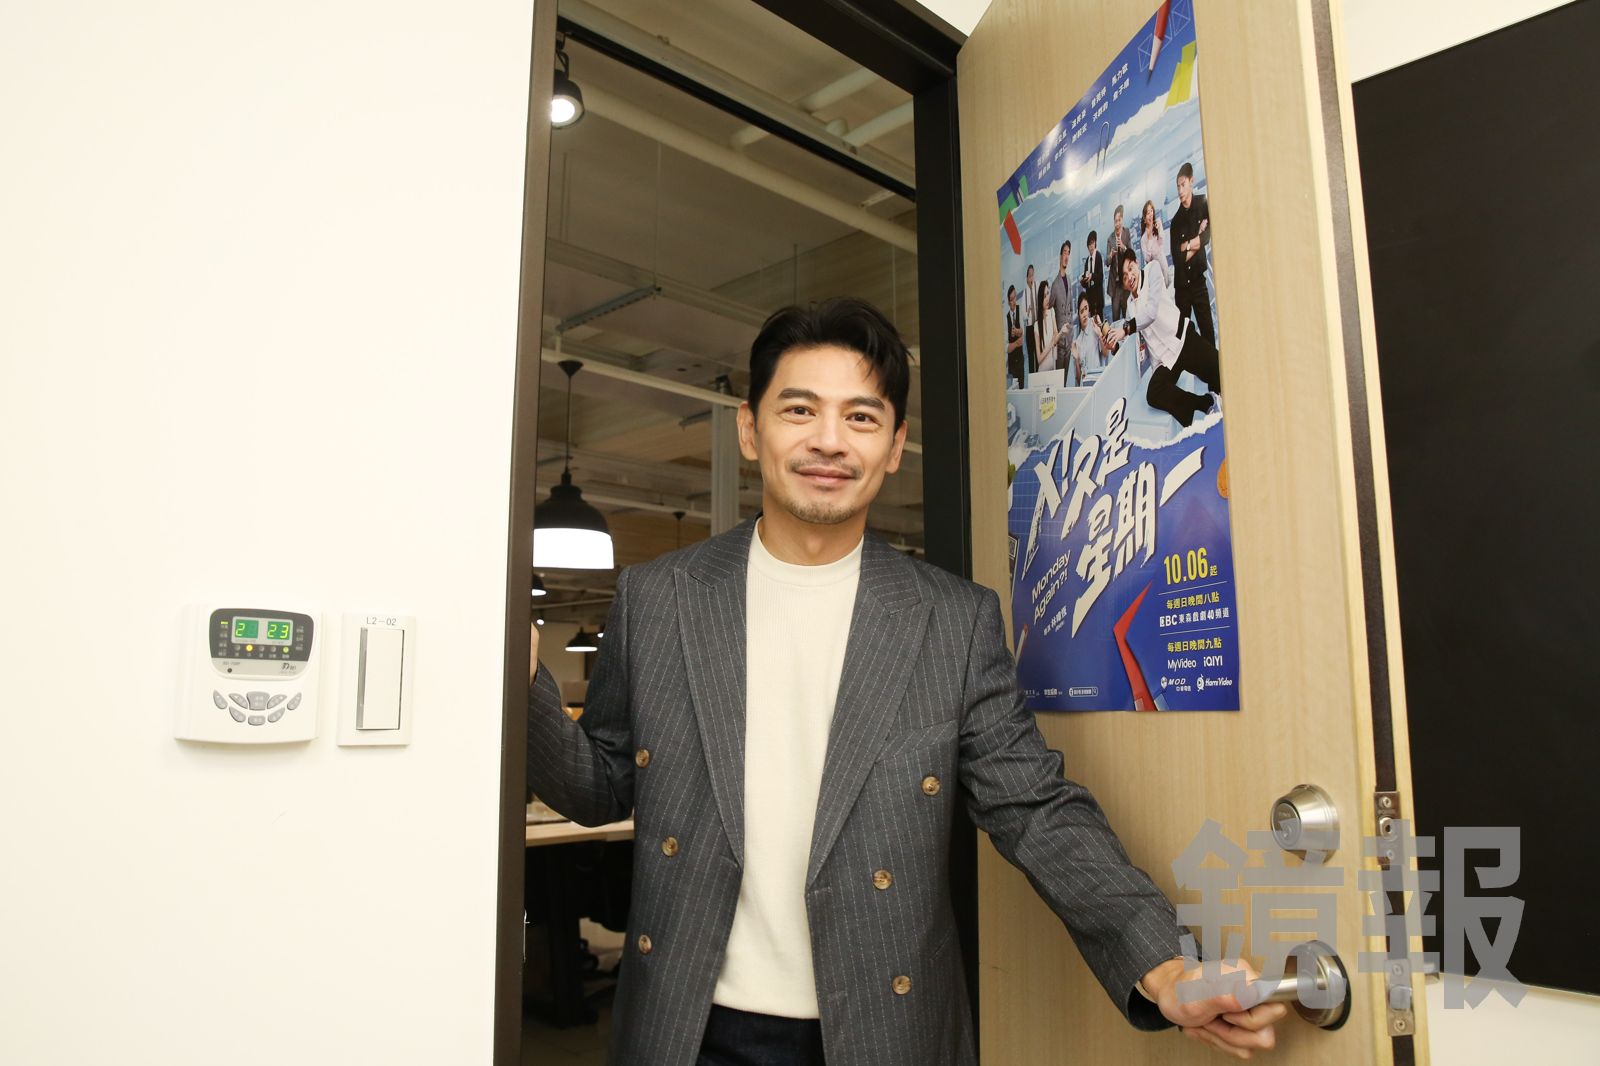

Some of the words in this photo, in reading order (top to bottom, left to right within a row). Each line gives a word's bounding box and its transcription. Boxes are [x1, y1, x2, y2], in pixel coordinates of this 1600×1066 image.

[1163, 547, 1209, 585] 10.06
[1031, 549, 1071, 604] Monday
[1033, 568, 1068, 626] Again?!
[1166, 591, 1220, 610] 每週日晚間八點
[366, 616, 397, 626] L2-02
[1159, 614, 1178, 628] EBC
[266, 624, 289, 639] 23
[1167, 637, 1222, 653] 每週日晚間九點
[1167, 657, 1197, 672] MyVideo
[1203, 655, 1223, 667] iQIYI
